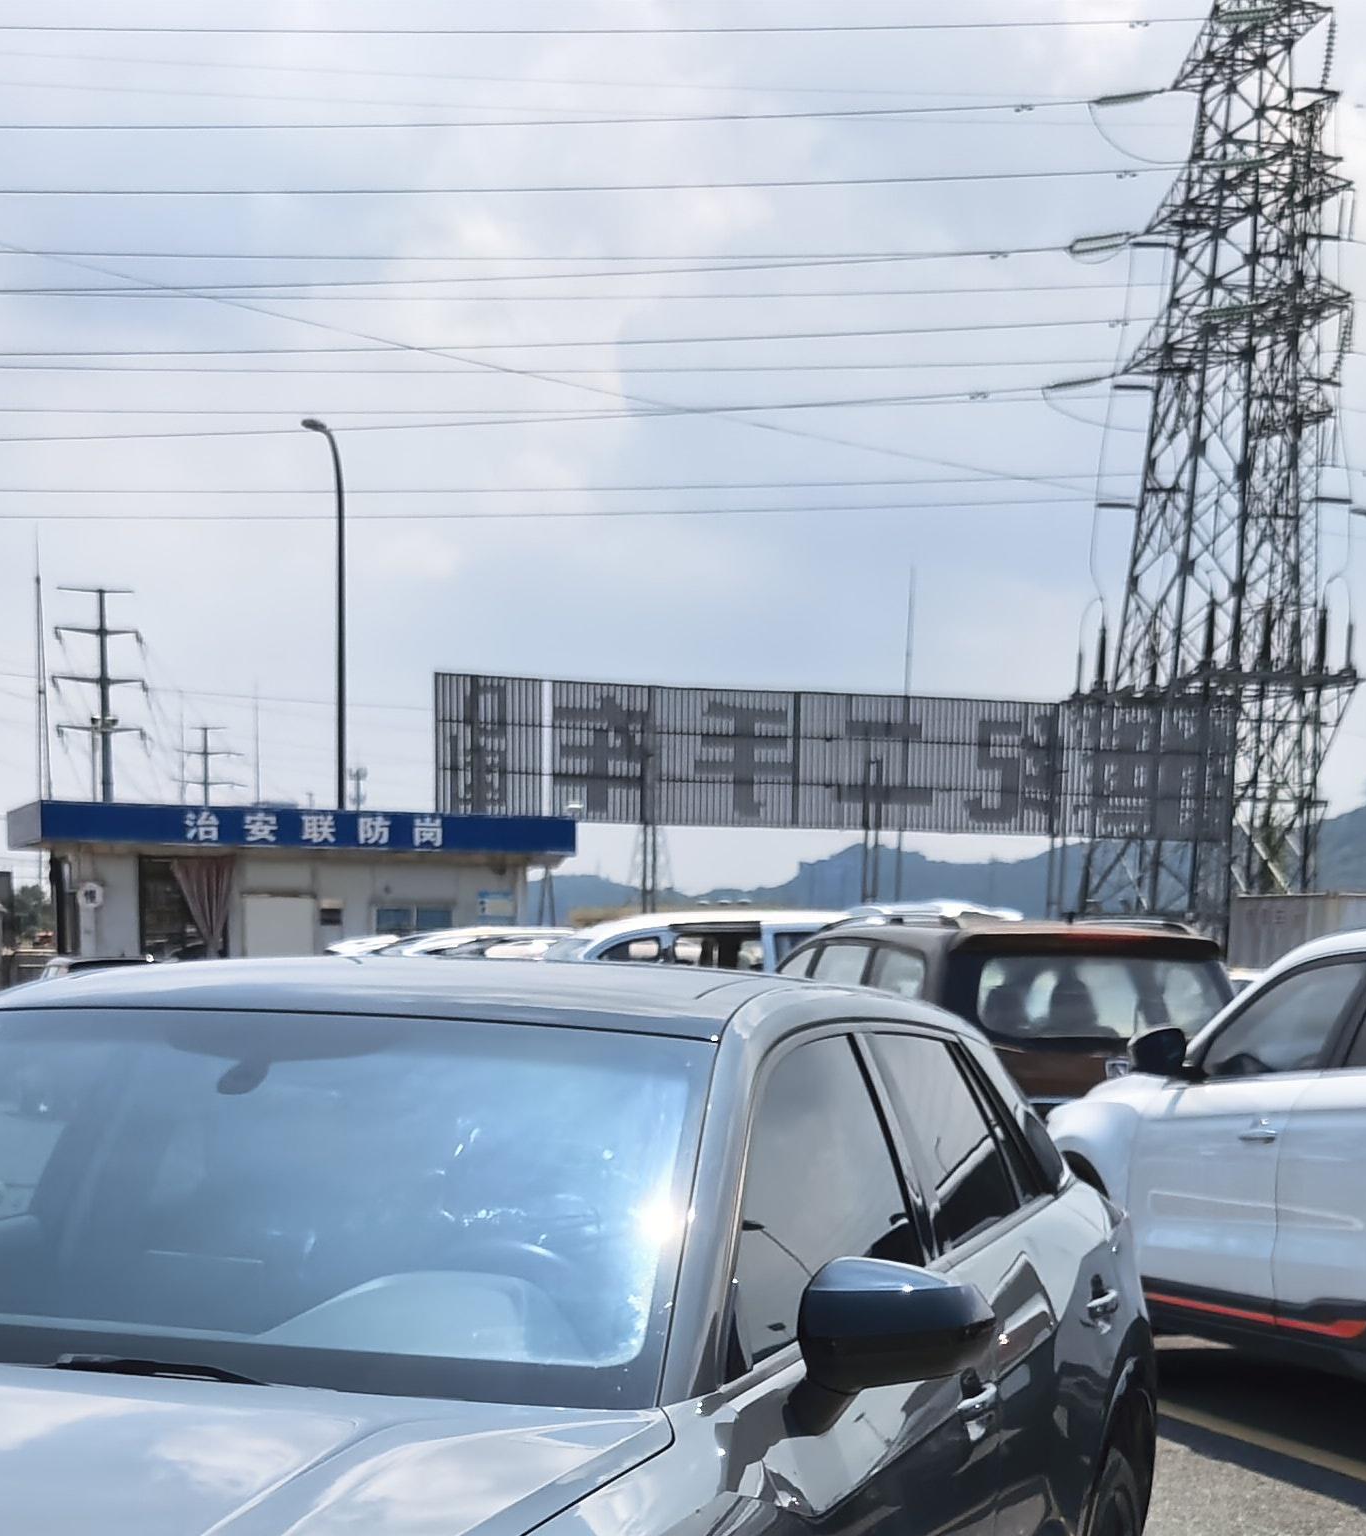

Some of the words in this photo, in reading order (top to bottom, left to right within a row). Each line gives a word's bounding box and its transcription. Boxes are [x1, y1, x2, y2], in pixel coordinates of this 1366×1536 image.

[183, 811, 444, 848] 治安联防岗
